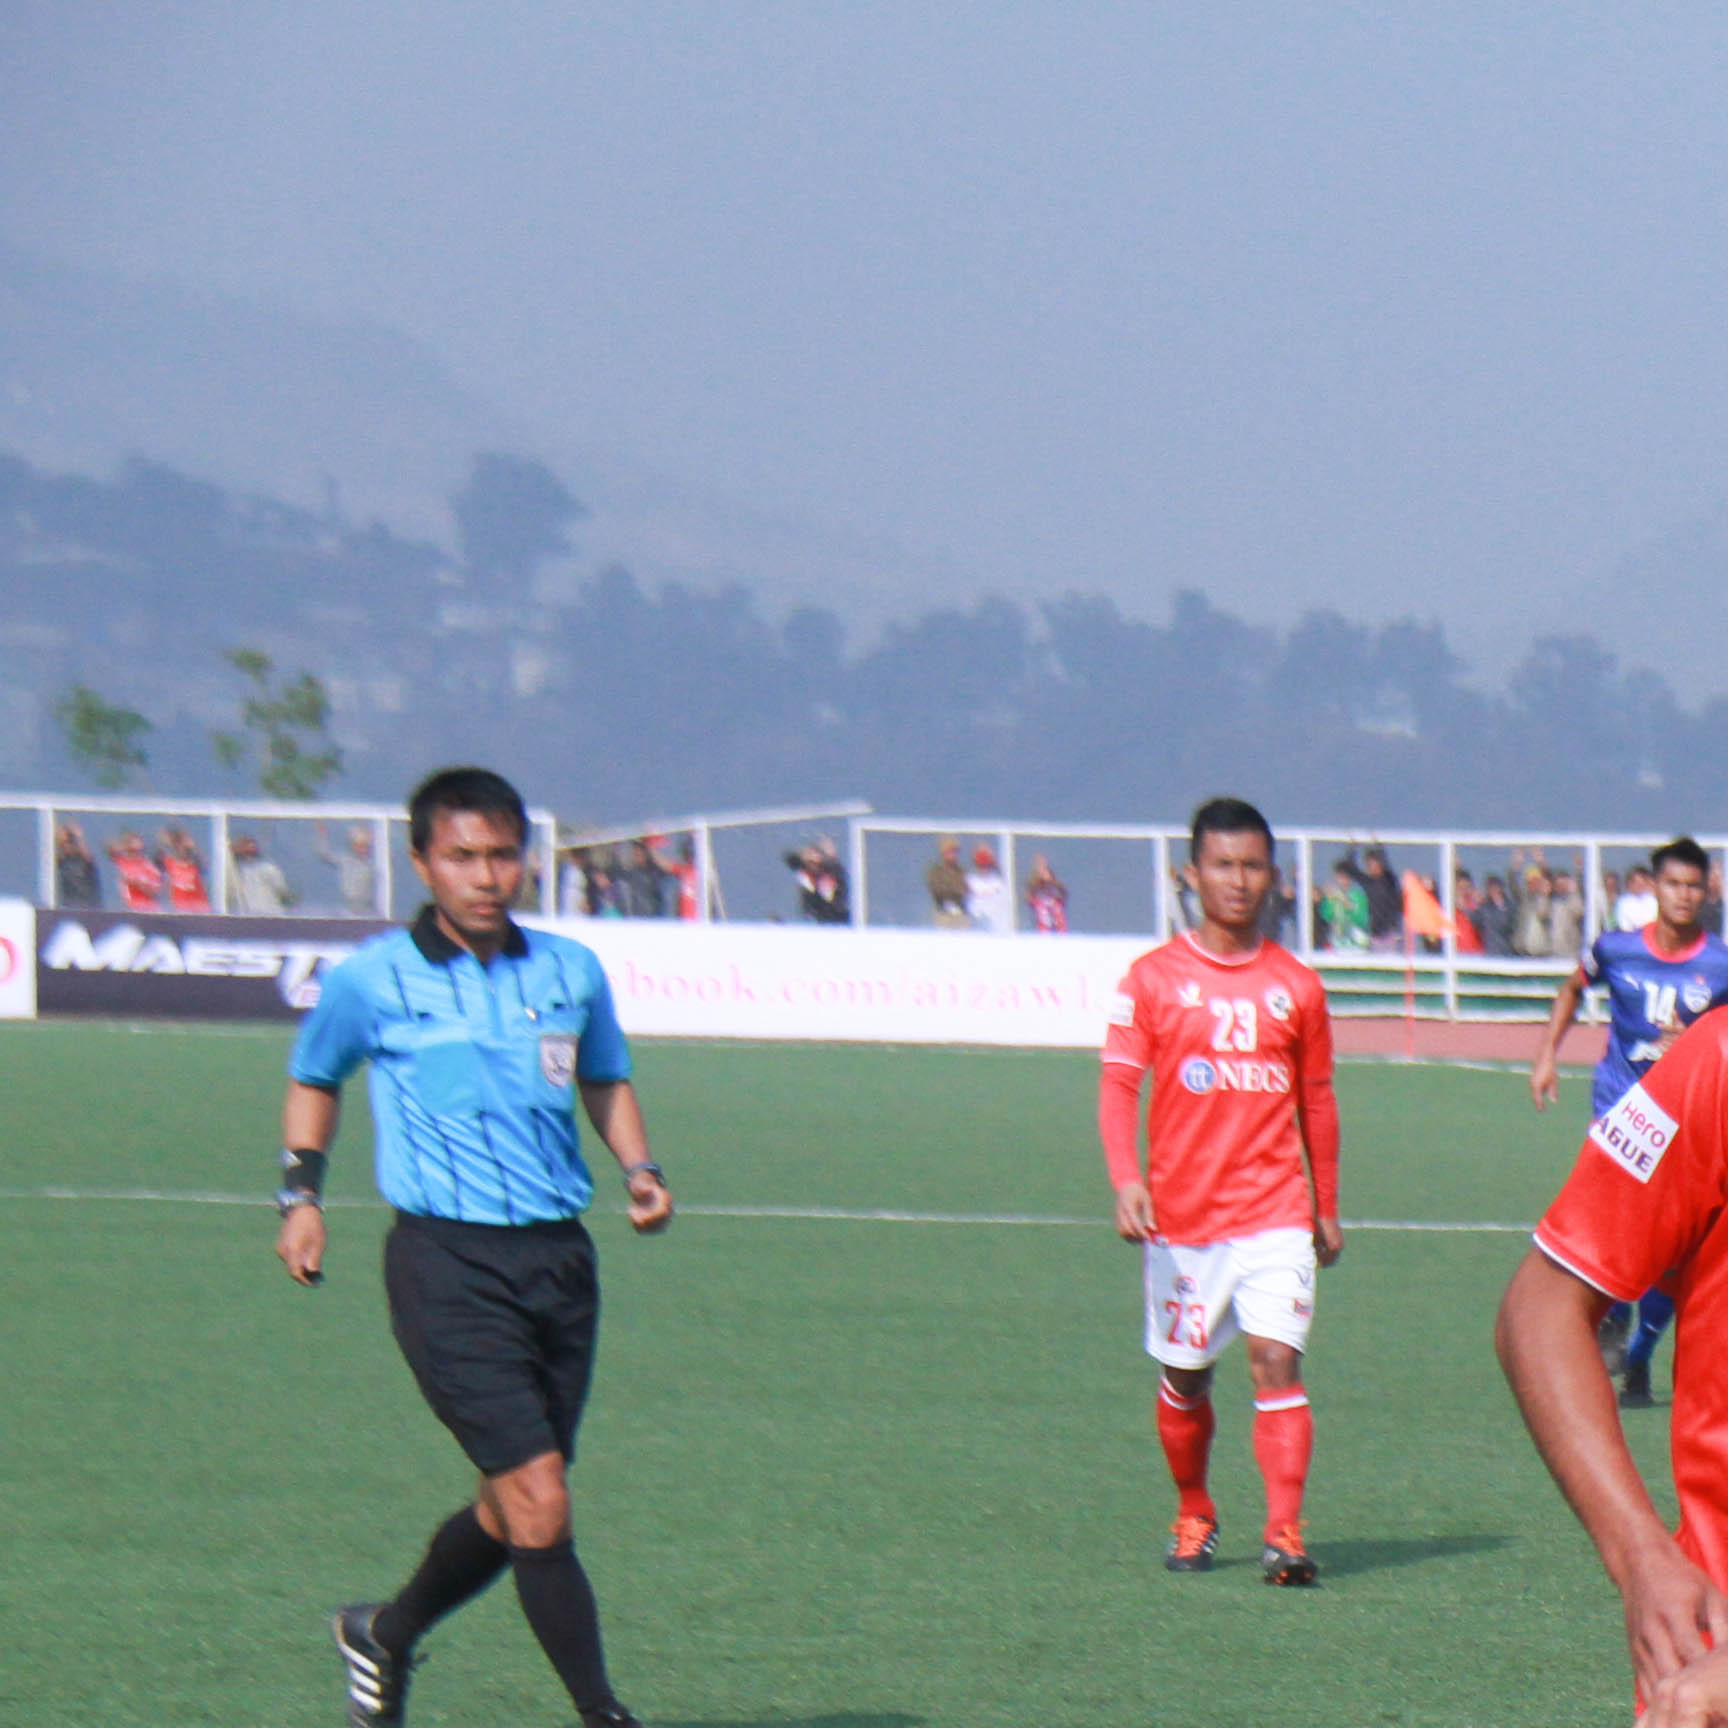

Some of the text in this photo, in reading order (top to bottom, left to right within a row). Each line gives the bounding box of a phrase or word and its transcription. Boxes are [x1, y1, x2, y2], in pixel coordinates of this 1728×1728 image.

[42, 918, 352, 1000] MAEST
[1209, 997, 1258, 1053] 23
[1215, 1055, 1291, 1093] NECS
[1621, 1099, 1666, 1149] Hero
[1165, 1299, 1209, 1350] 23
